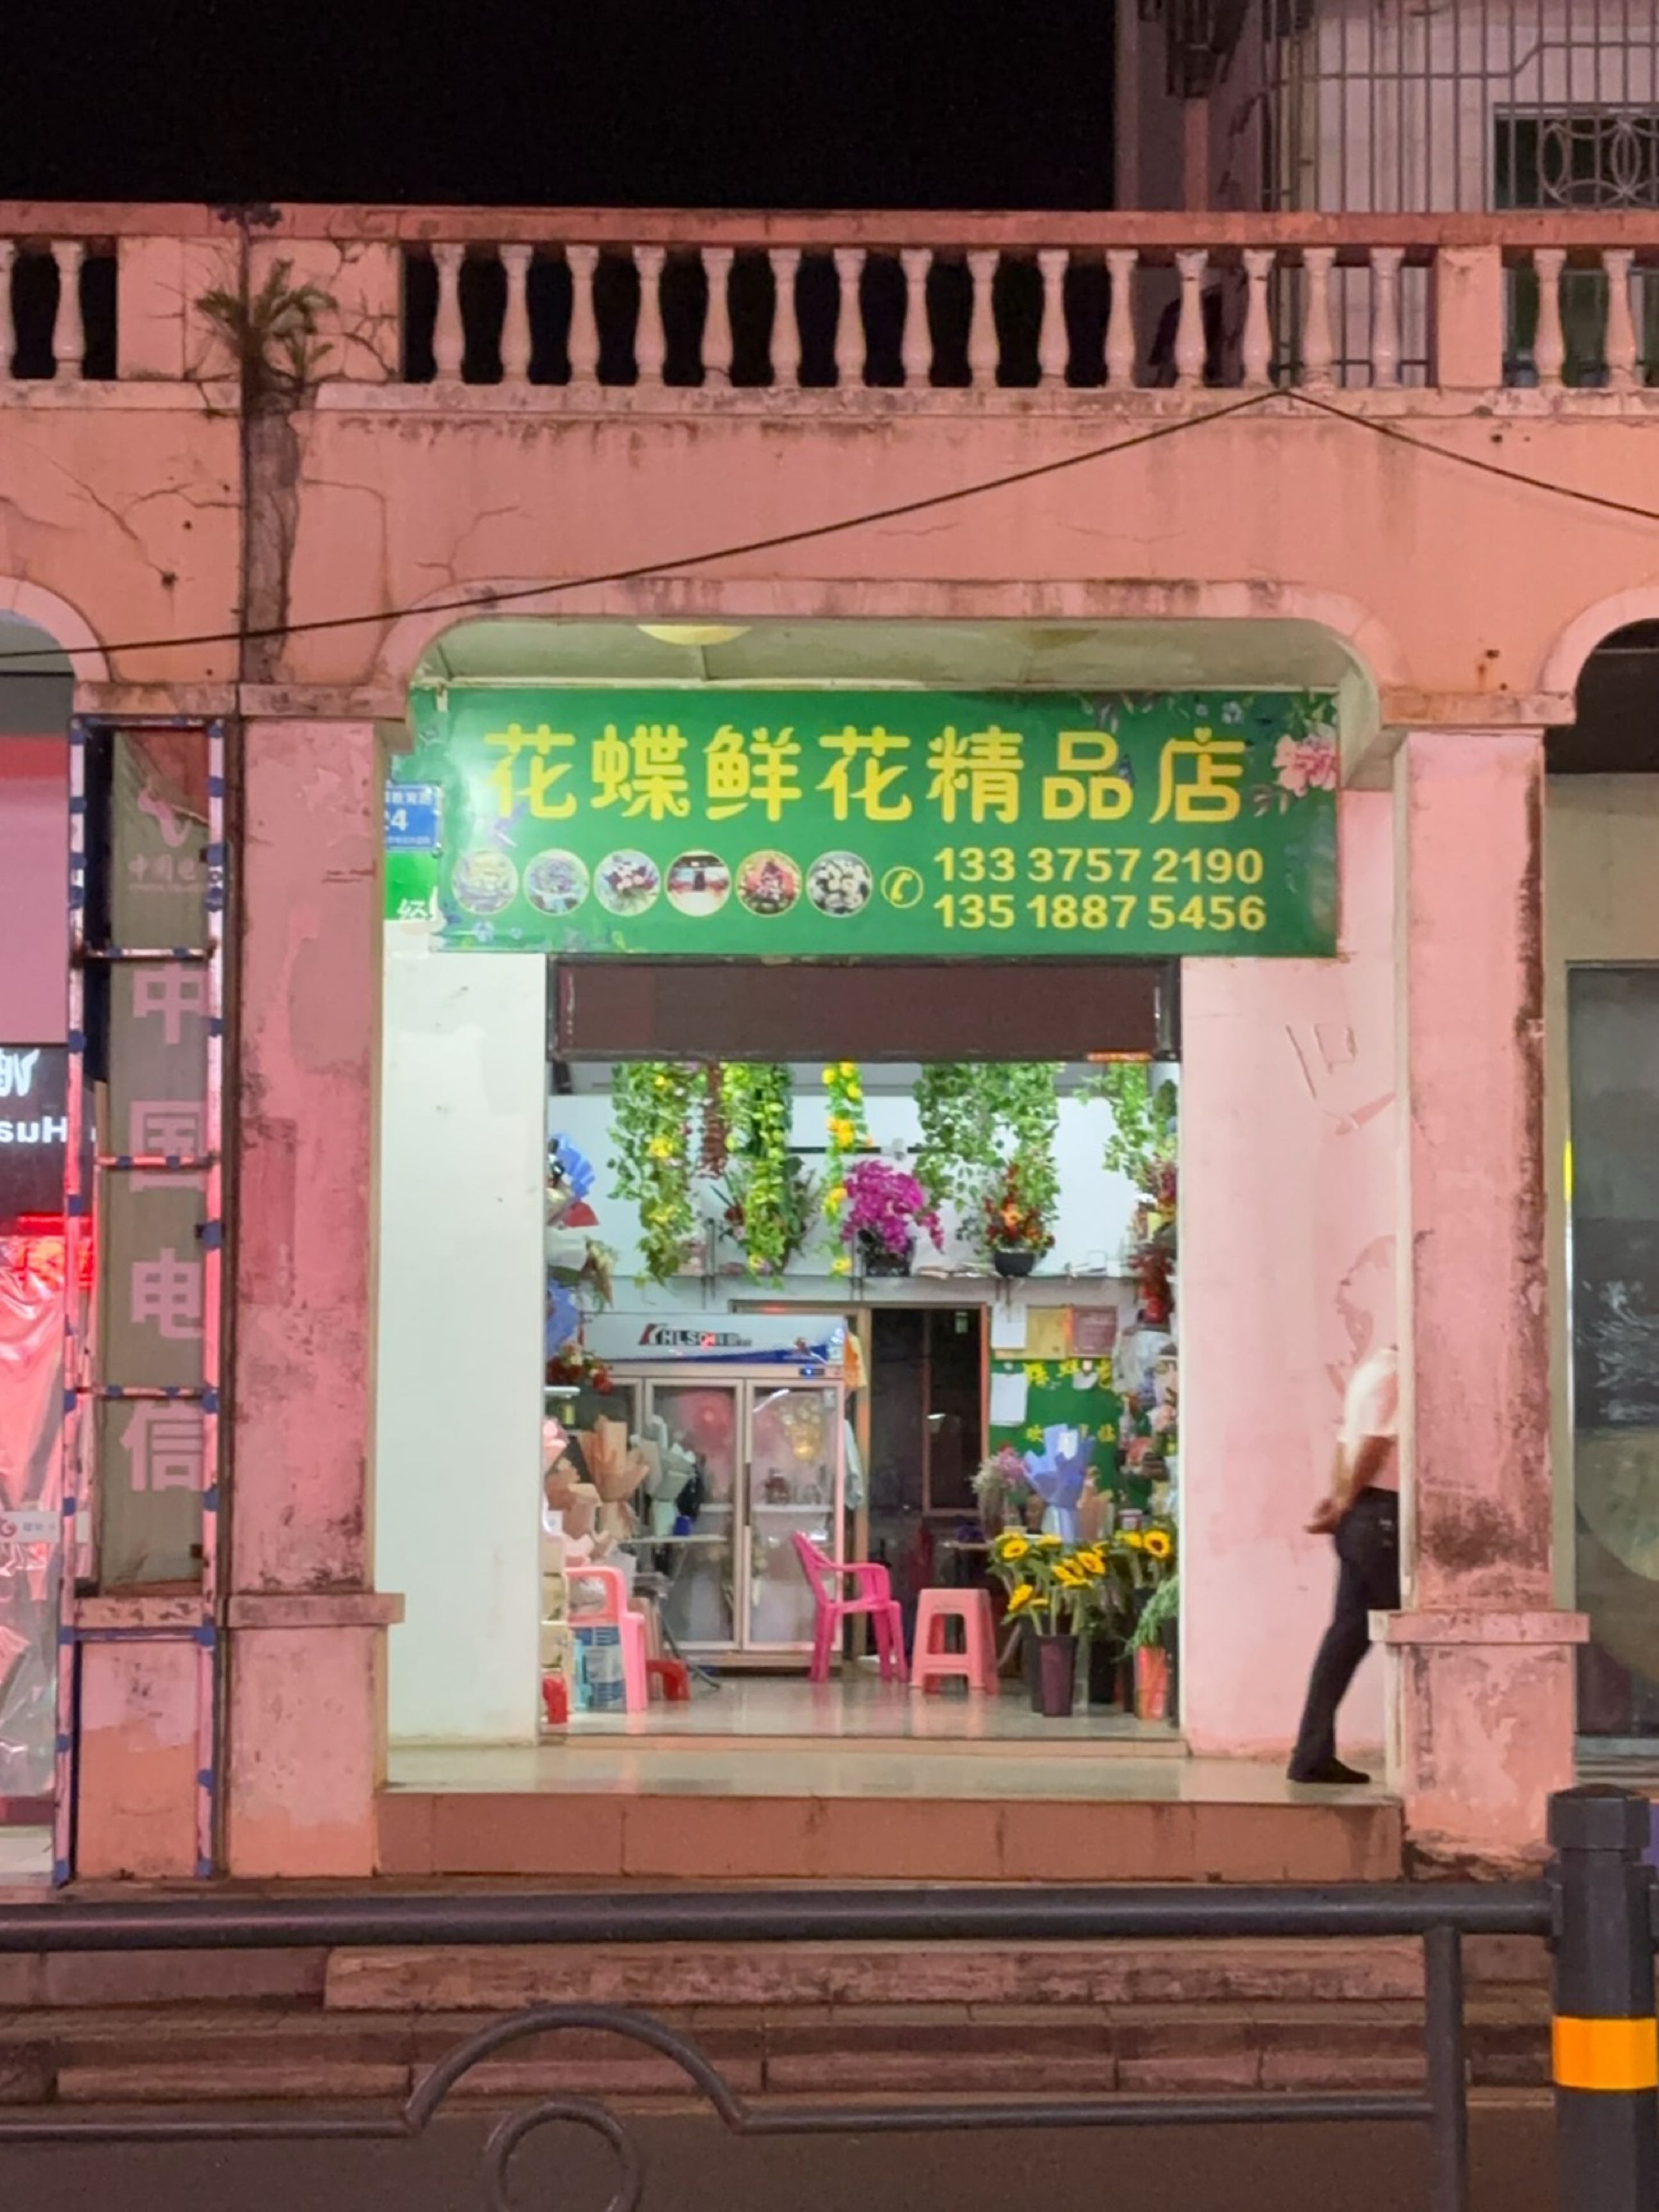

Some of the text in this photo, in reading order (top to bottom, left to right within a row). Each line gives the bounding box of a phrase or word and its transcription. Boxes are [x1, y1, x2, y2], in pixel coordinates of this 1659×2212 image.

[483, 723, 1246, 824] 花蝶鲜花精品店
[936, 847, 1263, 884] 133 3757 2190
[935, 894, 1266, 931] 135 1887 5456
[120, 963, 207, 1492] 中国电信
